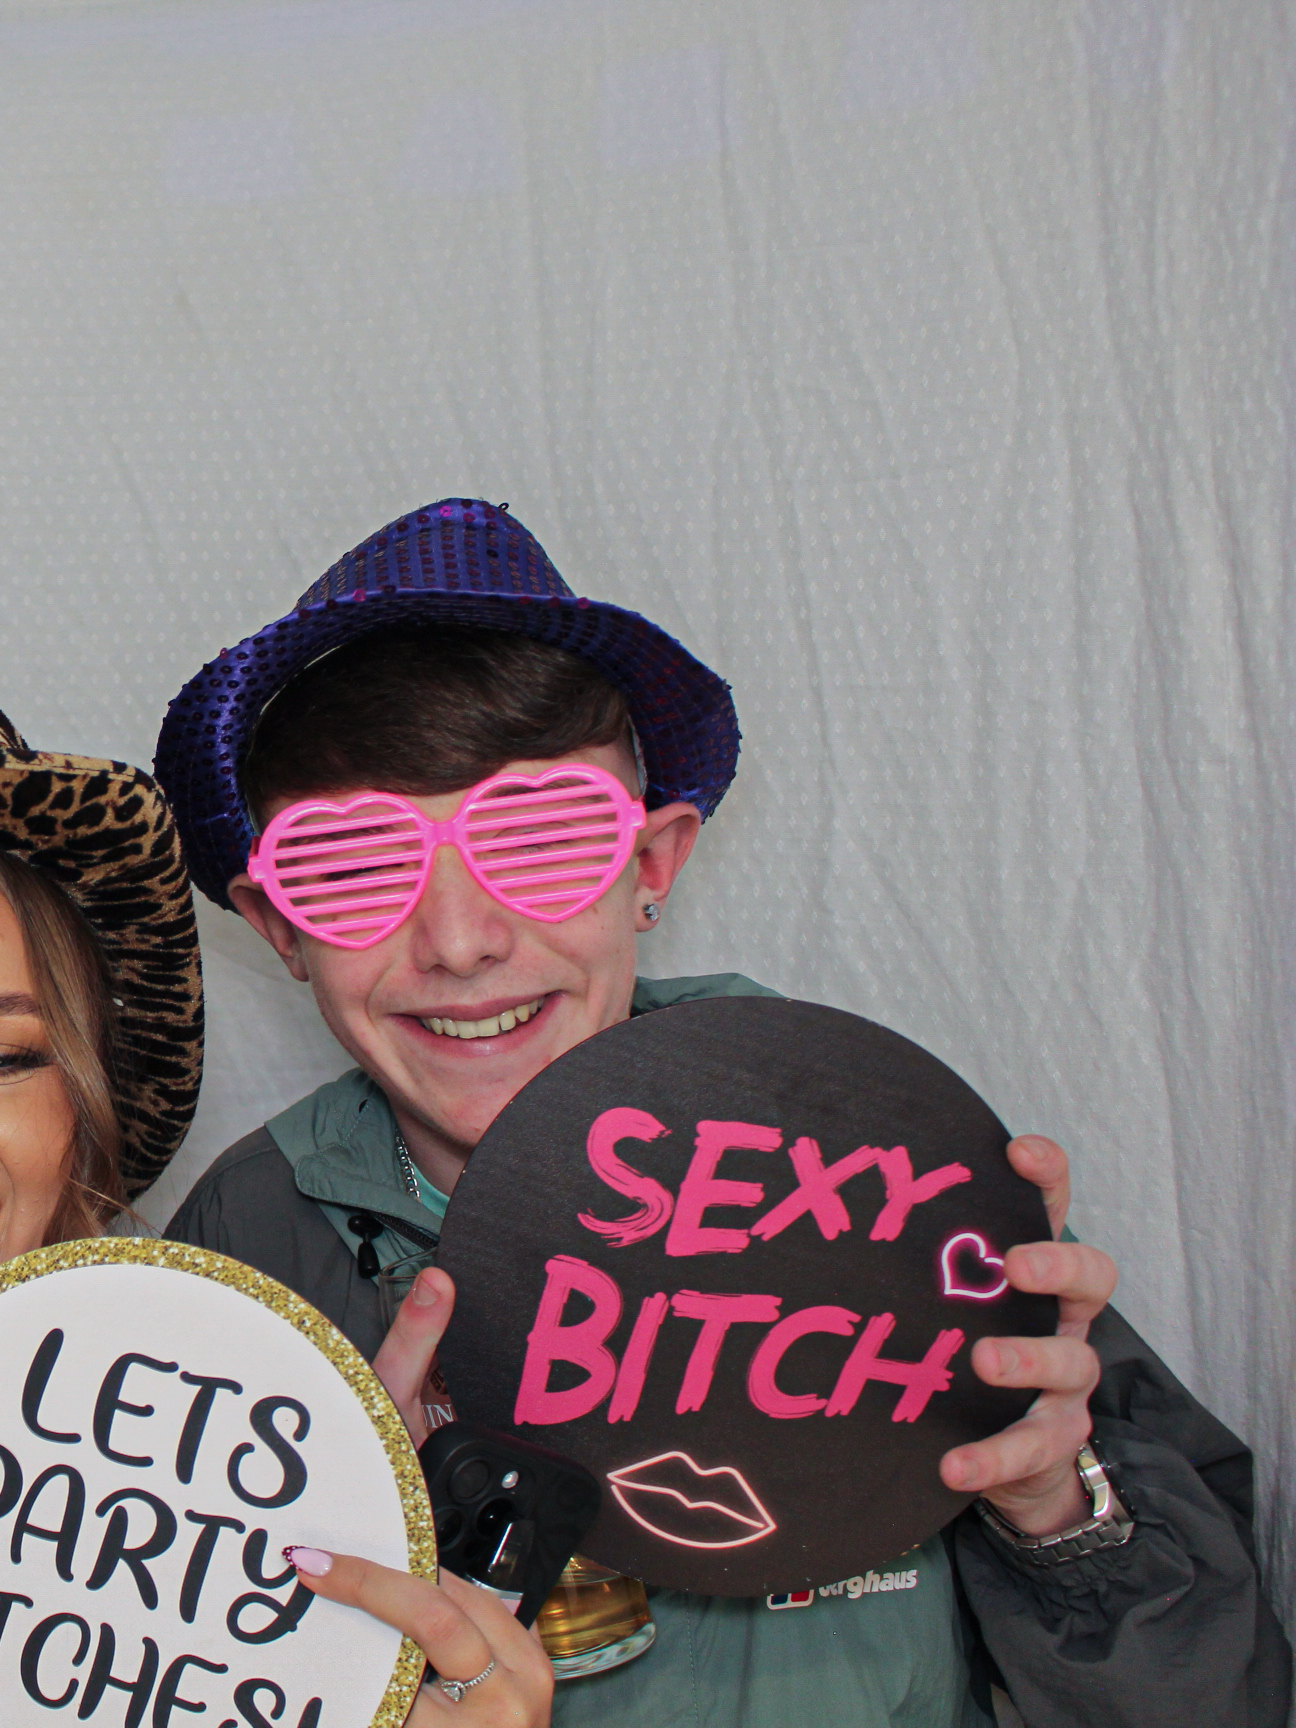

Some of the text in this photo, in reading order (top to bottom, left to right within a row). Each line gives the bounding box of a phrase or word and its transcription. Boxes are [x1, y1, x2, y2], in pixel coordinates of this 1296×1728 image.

[576, 1106, 973, 1258] SEXY
[21, 1328, 312, 1510] LETS
[513, 1254, 966, 1426] BITCH
